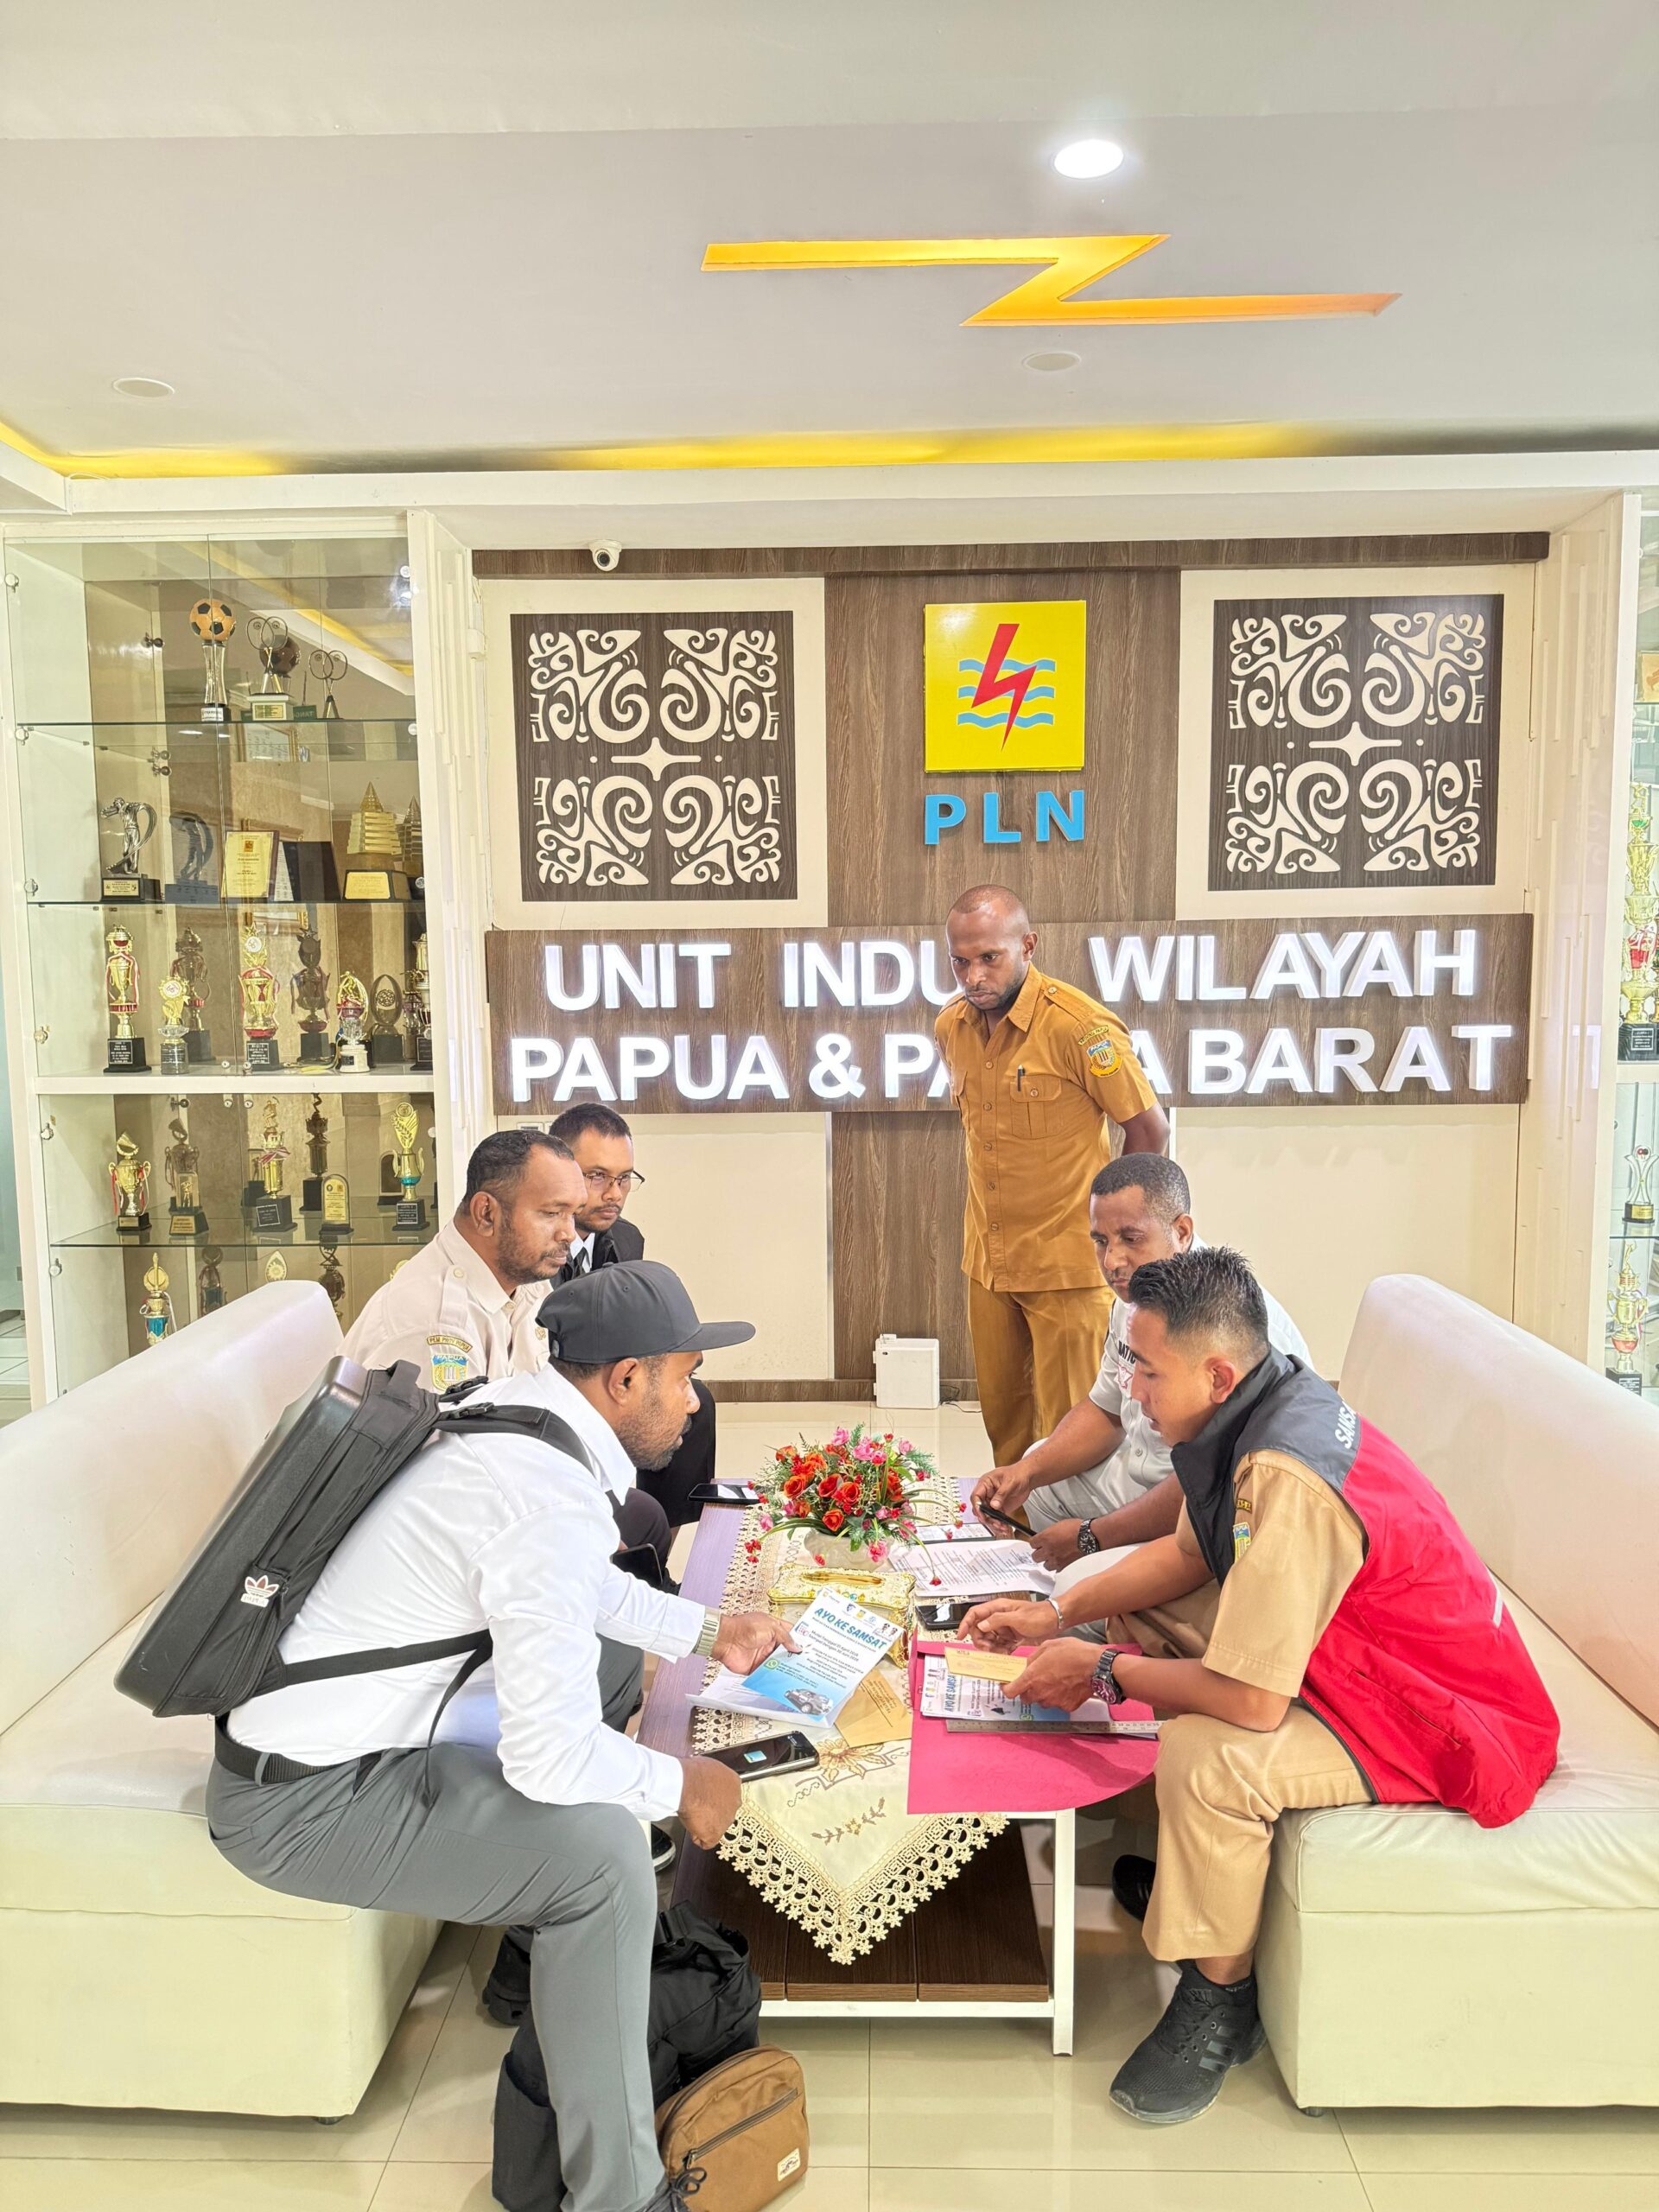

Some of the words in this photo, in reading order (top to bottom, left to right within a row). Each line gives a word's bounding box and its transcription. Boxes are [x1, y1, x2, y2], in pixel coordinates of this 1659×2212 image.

[924, 790, 1084, 846] PLN
[544, 942, 732, 1012] UNIT
[784, 939, 963, 1009] INDU
[1087, 928, 1478, 1002] WILAYAH
[510, 1034, 791, 1103] PAPUA
[808, 1033, 867, 1100] &
[1187, 1023, 1513, 1095] BARAT
[815, 1608, 836, 1623] AYO
[835, 1618, 849, 1630] KE
[847, 1626, 887, 1649] SAMSAT
